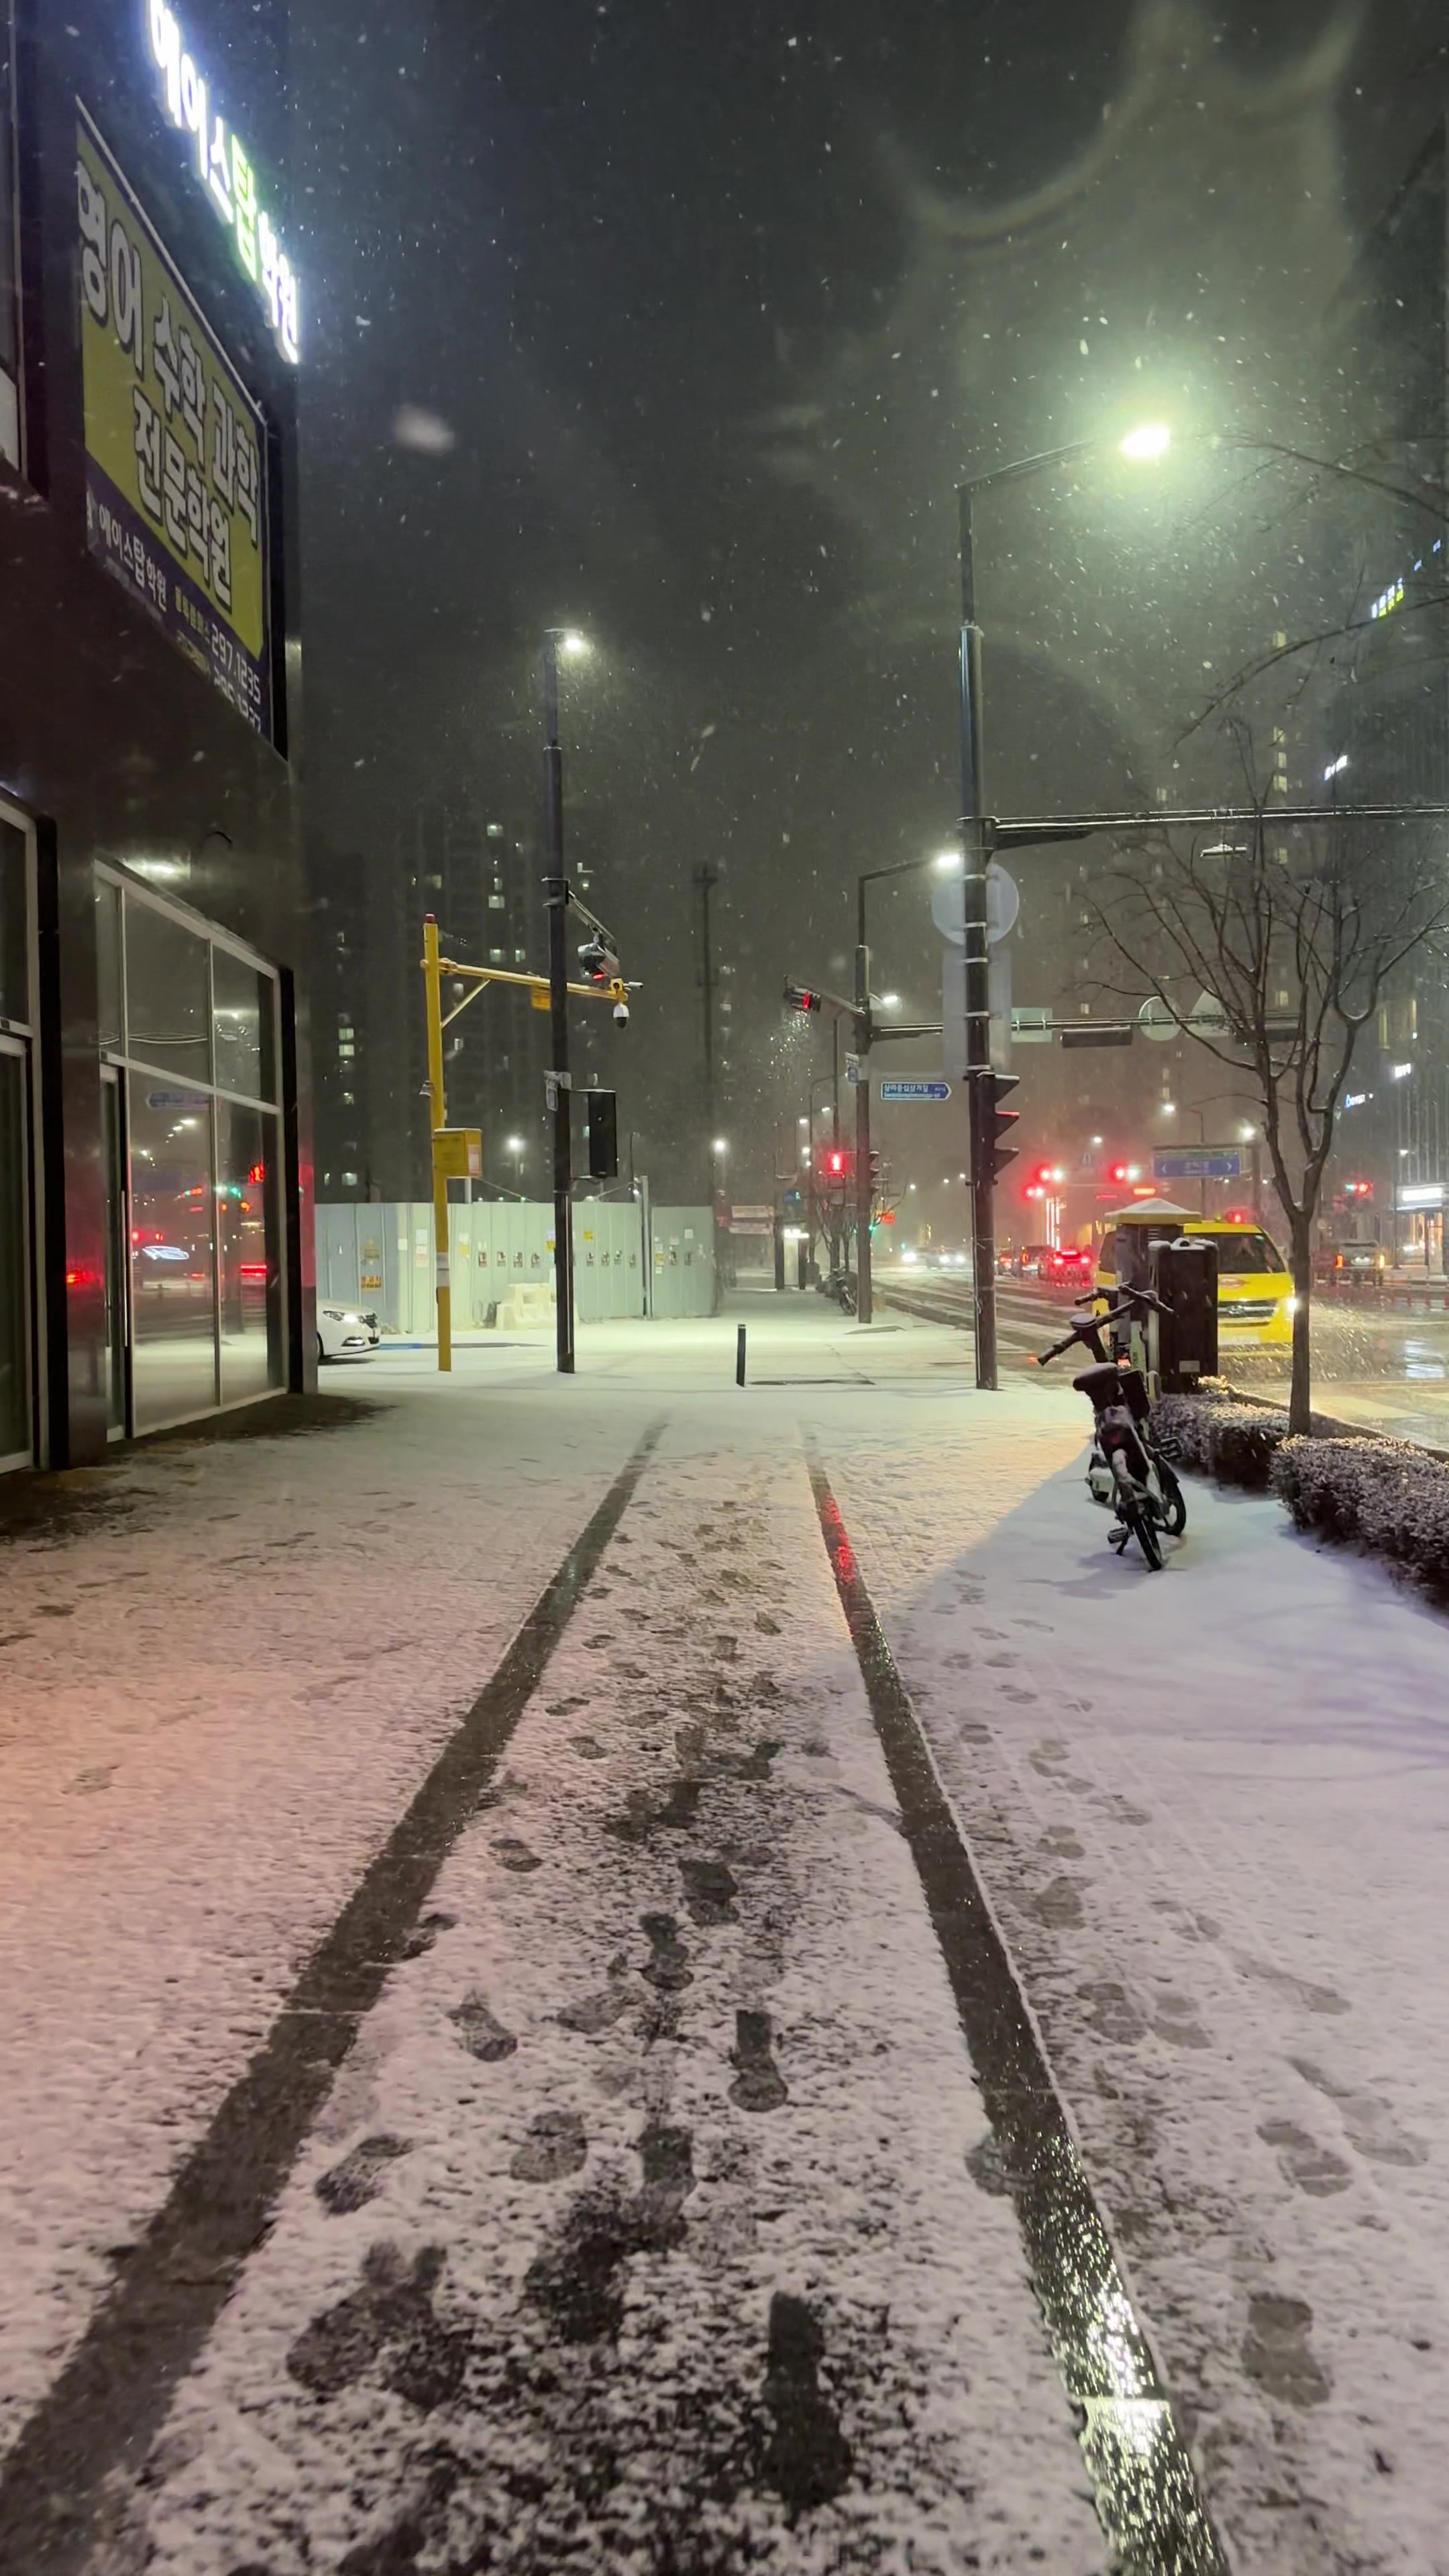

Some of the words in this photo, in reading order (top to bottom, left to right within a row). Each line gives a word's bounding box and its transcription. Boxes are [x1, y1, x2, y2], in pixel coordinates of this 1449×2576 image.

[77, 160, 143, 377] 영어
[154, 294, 205, 468] 수학
[213, 381, 259, 547] 과학
[99, 504, 167, 612] 에이스탑학원
[133, 388, 231, 609] 전문학원
